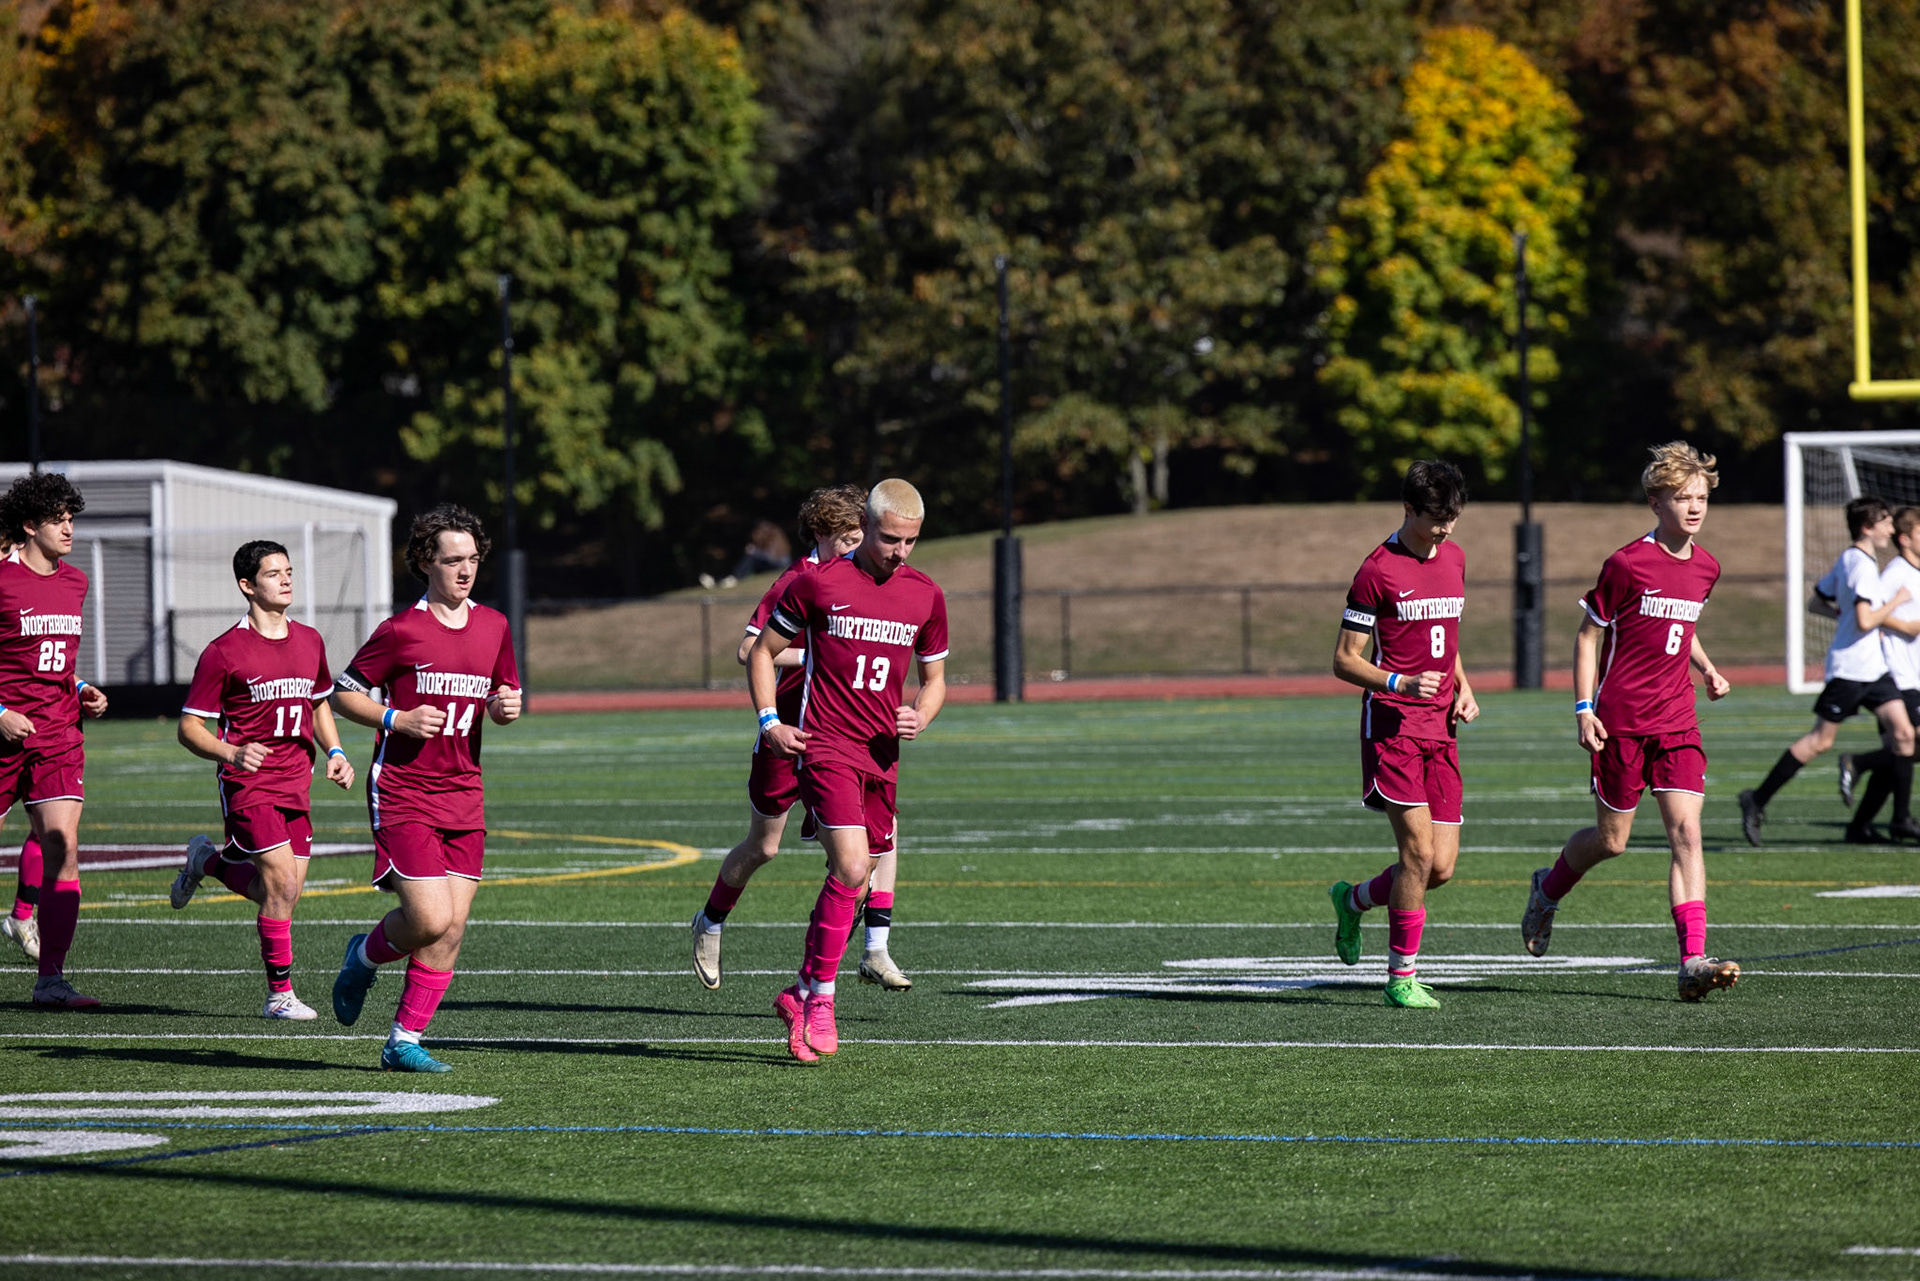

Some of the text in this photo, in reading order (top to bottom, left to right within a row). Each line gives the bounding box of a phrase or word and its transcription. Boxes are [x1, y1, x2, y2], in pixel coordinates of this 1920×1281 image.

[827, 615, 919, 647] NORTHBRIDGE
[1430, 625, 1446, 658] 8
[1665, 623, 1684, 656] 6
[38, 640, 67, 672] 25
[416, 671, 492, 699] NORTHBRIDG
[852, 654, 891, 692] 13
[273, 705, 303, 737] 17
[443, 702, 476, 737] 14
